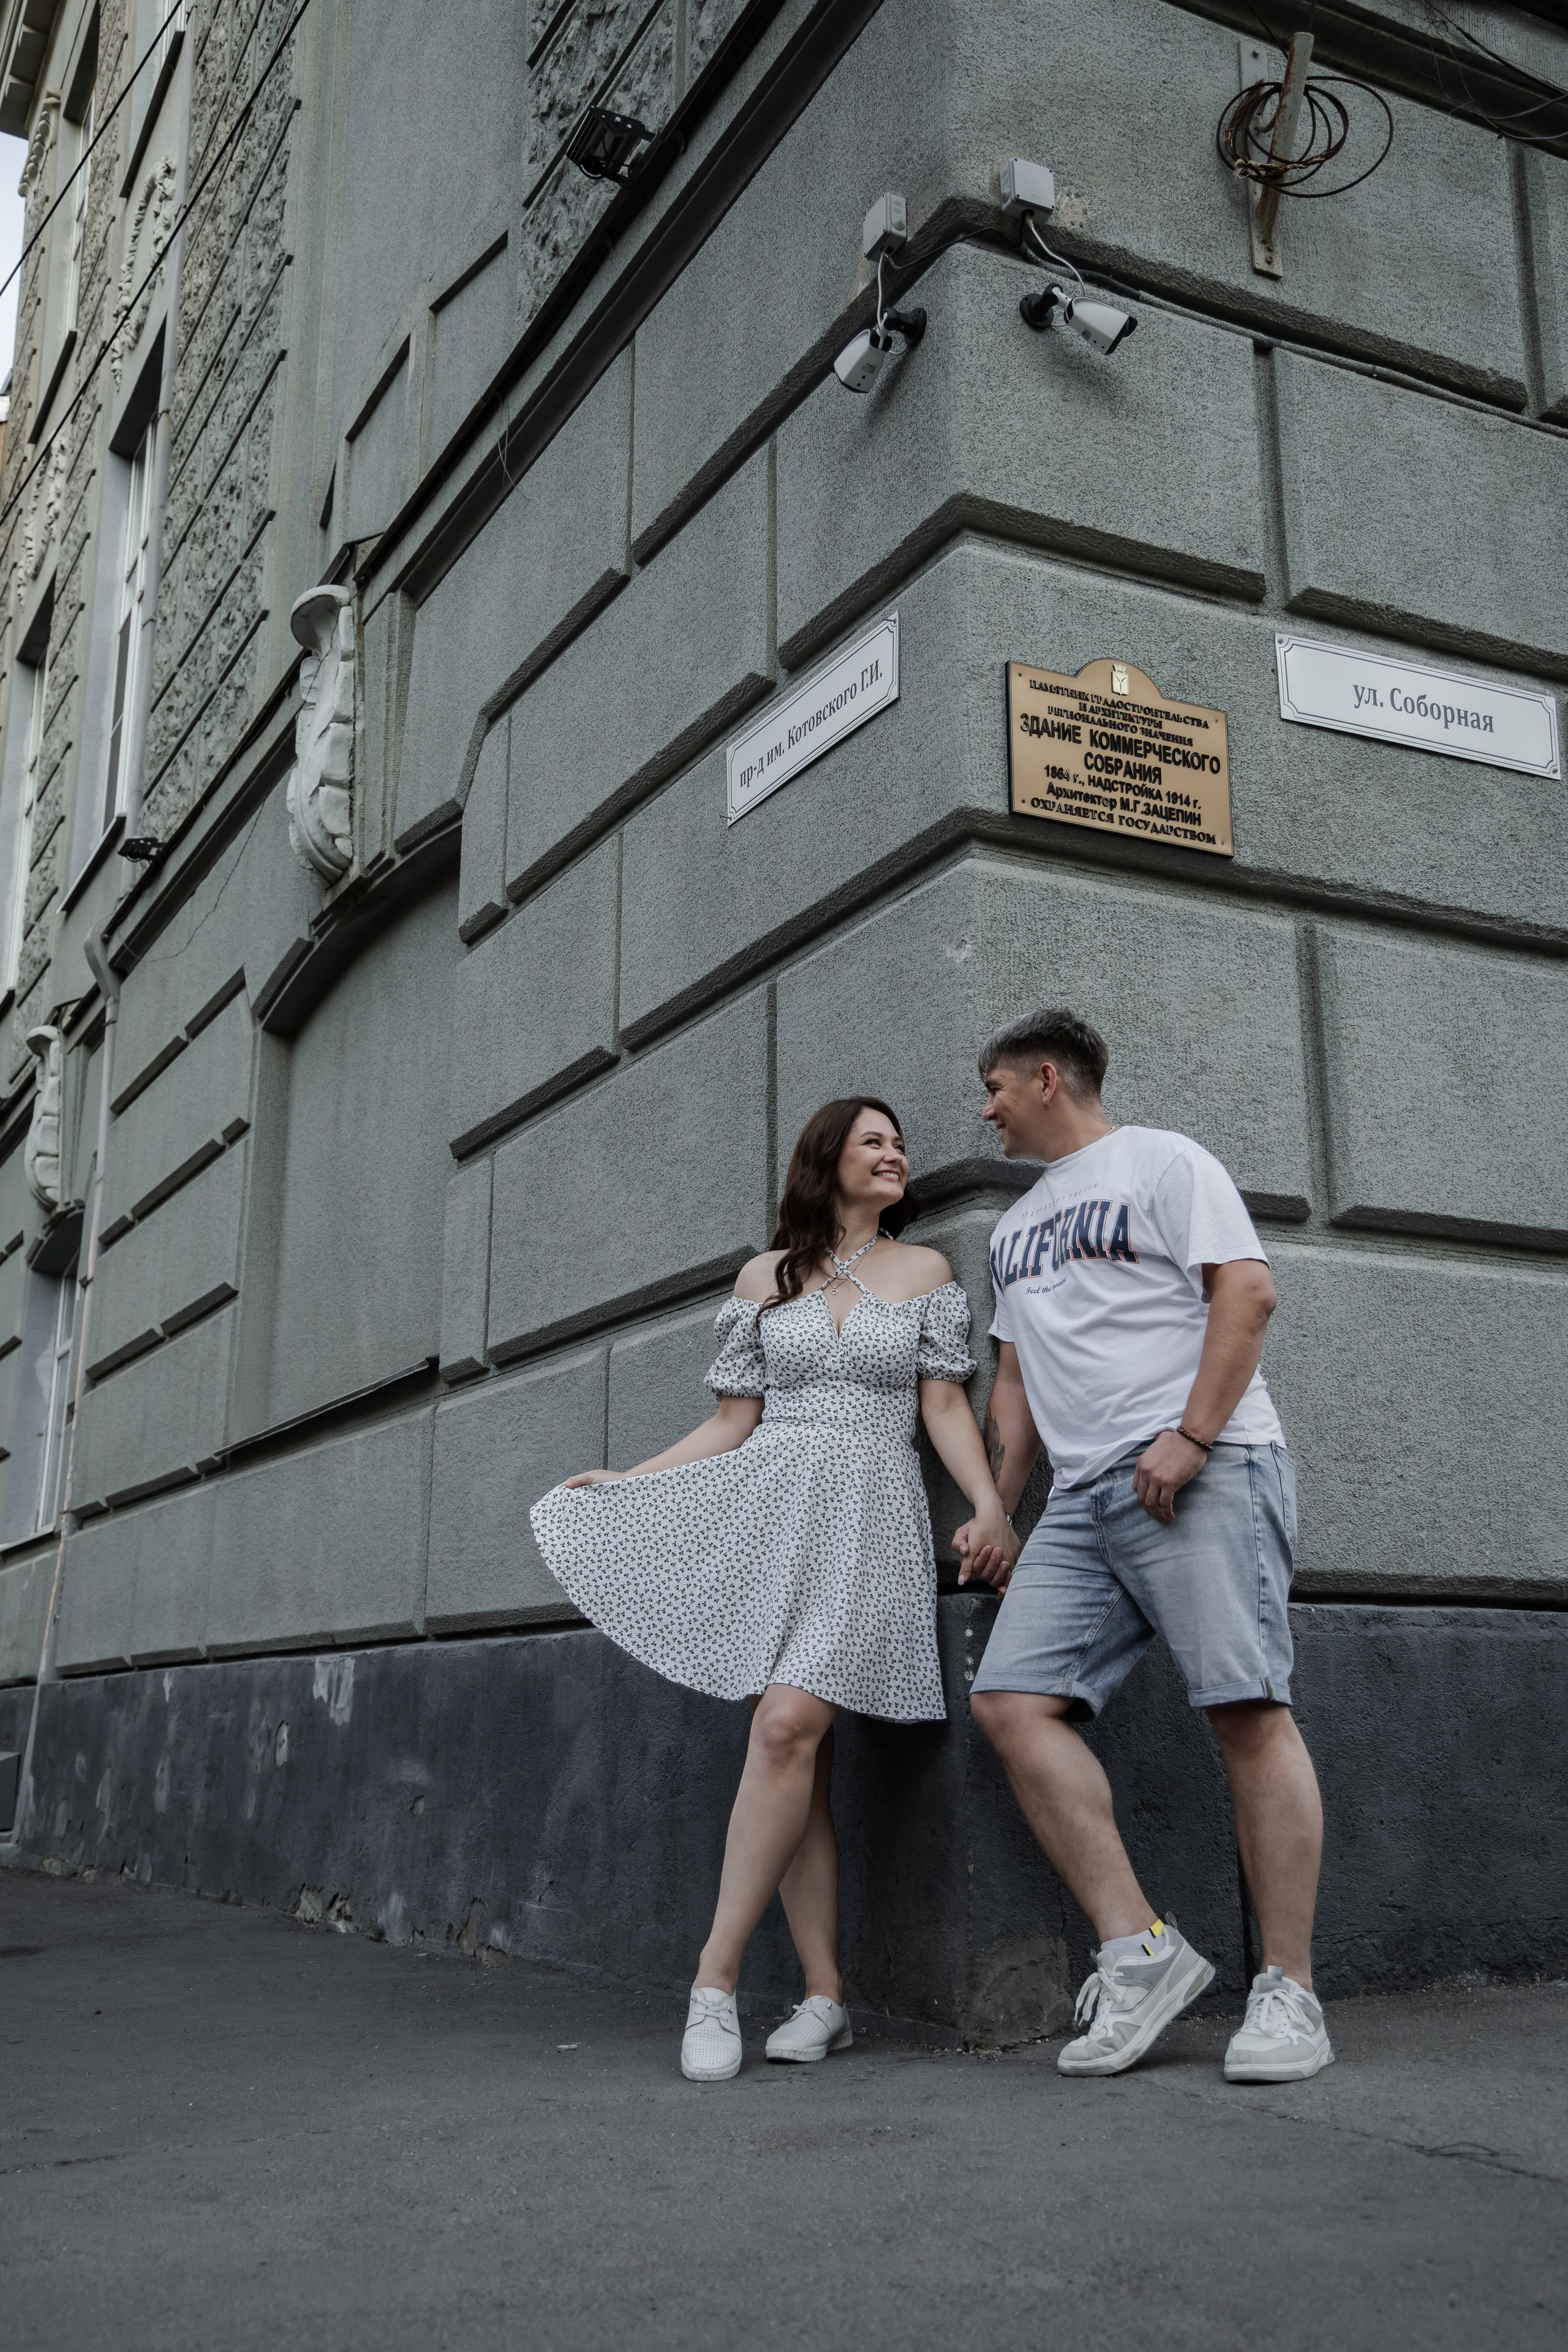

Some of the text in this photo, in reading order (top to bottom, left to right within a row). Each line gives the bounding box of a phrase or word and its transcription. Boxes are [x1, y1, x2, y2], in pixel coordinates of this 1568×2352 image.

[740, 658, 883, 788] пр-д им. Котовского Г.И.
[1030, 679, 1209, 729] ПАМЯТНИК ГРАДОСТРОИТЕЛЬСТВА
[1047, 706, 1194, 747] РЕГИОНАЛЬНОГО ЗНАЧЕНИЯ
[1079, 702, 1163, 729] И АРХИТЕКТУРЫ
[1352, 684, 1494, 733] ул. Соборная
[1020, 713, 1221, 774] ЗДАНИЕ КОММЕРЧЕСКОГО
[1044, 764, 1071, 782] 1864
[1088, 774, 1163, 801] НАДСТРОЙКА
[1165, 791, 1191, 807] 1914
[1193, 799, 1201, 809] г.
[1084, 752, 1162, 785] СОБРАНИЯ
[1046, 782, 1117, 811] Архитектор
[1031, 797, 1216, 845] ОХРАНЯЕТСЯ ГОСУДАРСТВОМ
